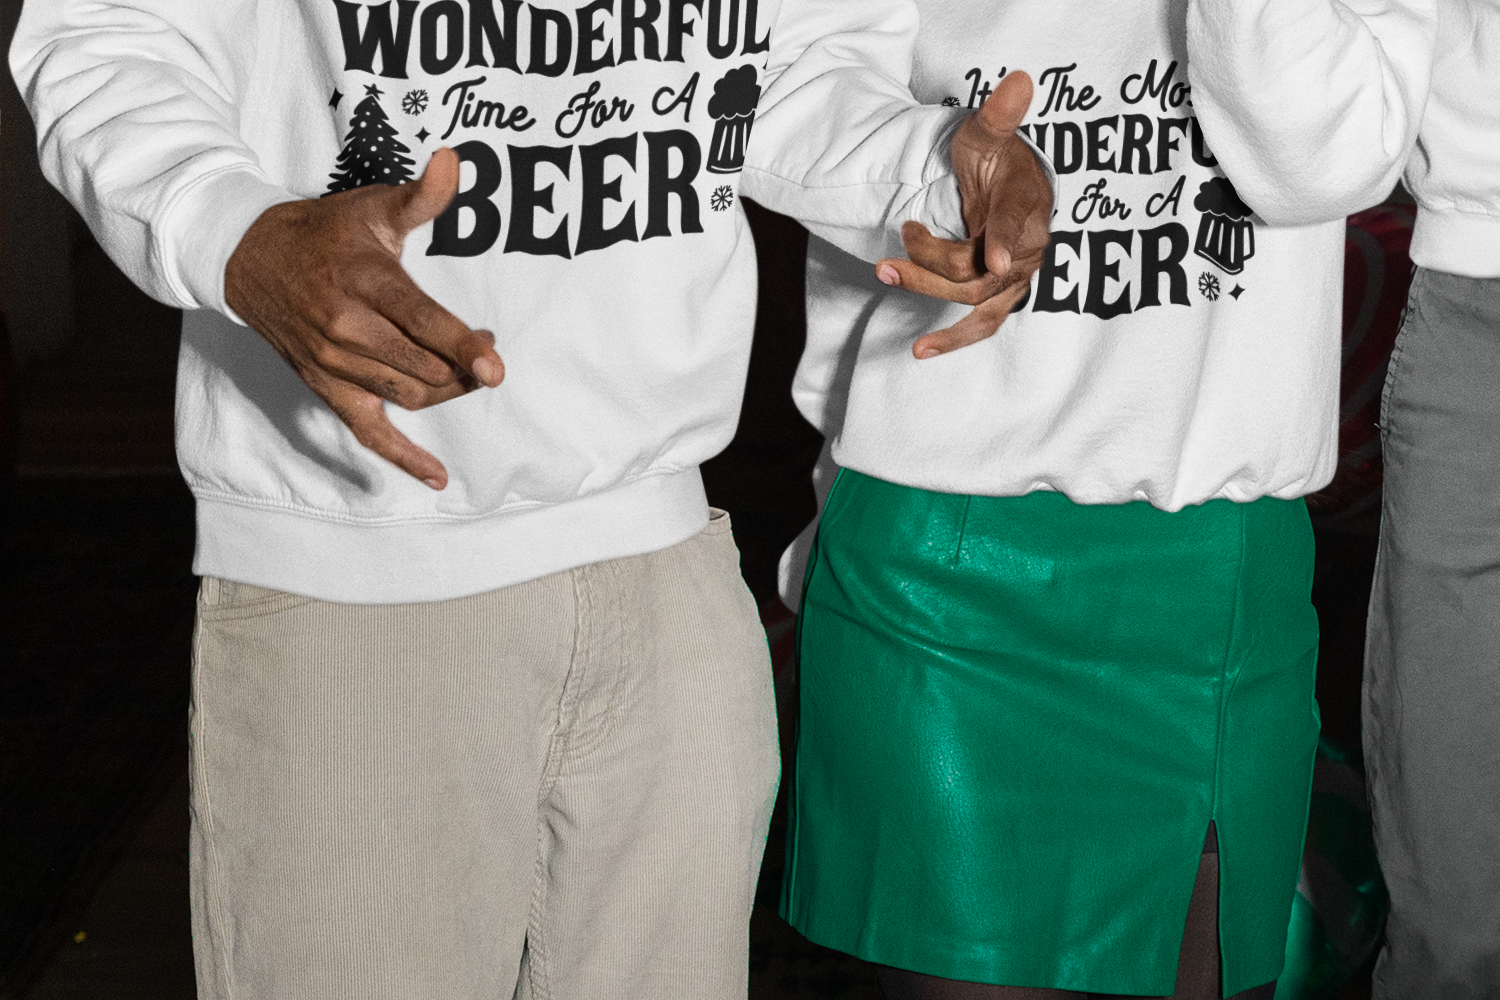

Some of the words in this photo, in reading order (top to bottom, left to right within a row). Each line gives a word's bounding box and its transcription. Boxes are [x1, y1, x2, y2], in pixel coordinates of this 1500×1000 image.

[441, 75, 536, 141] Time
[555, 80, 634, 139] For
[652, 71, 700, 123] A
[964, 66, 1007, 109] It'
[1038, 62, 1101, 118] The
[1120, 59, 1193, 112] Mo
[425, 128, 704, 260] BEER
[1071, 177, 1131, 225] For
[1145, 174, 1187, 218] A
[1008, 222, 1191, 321] EER
